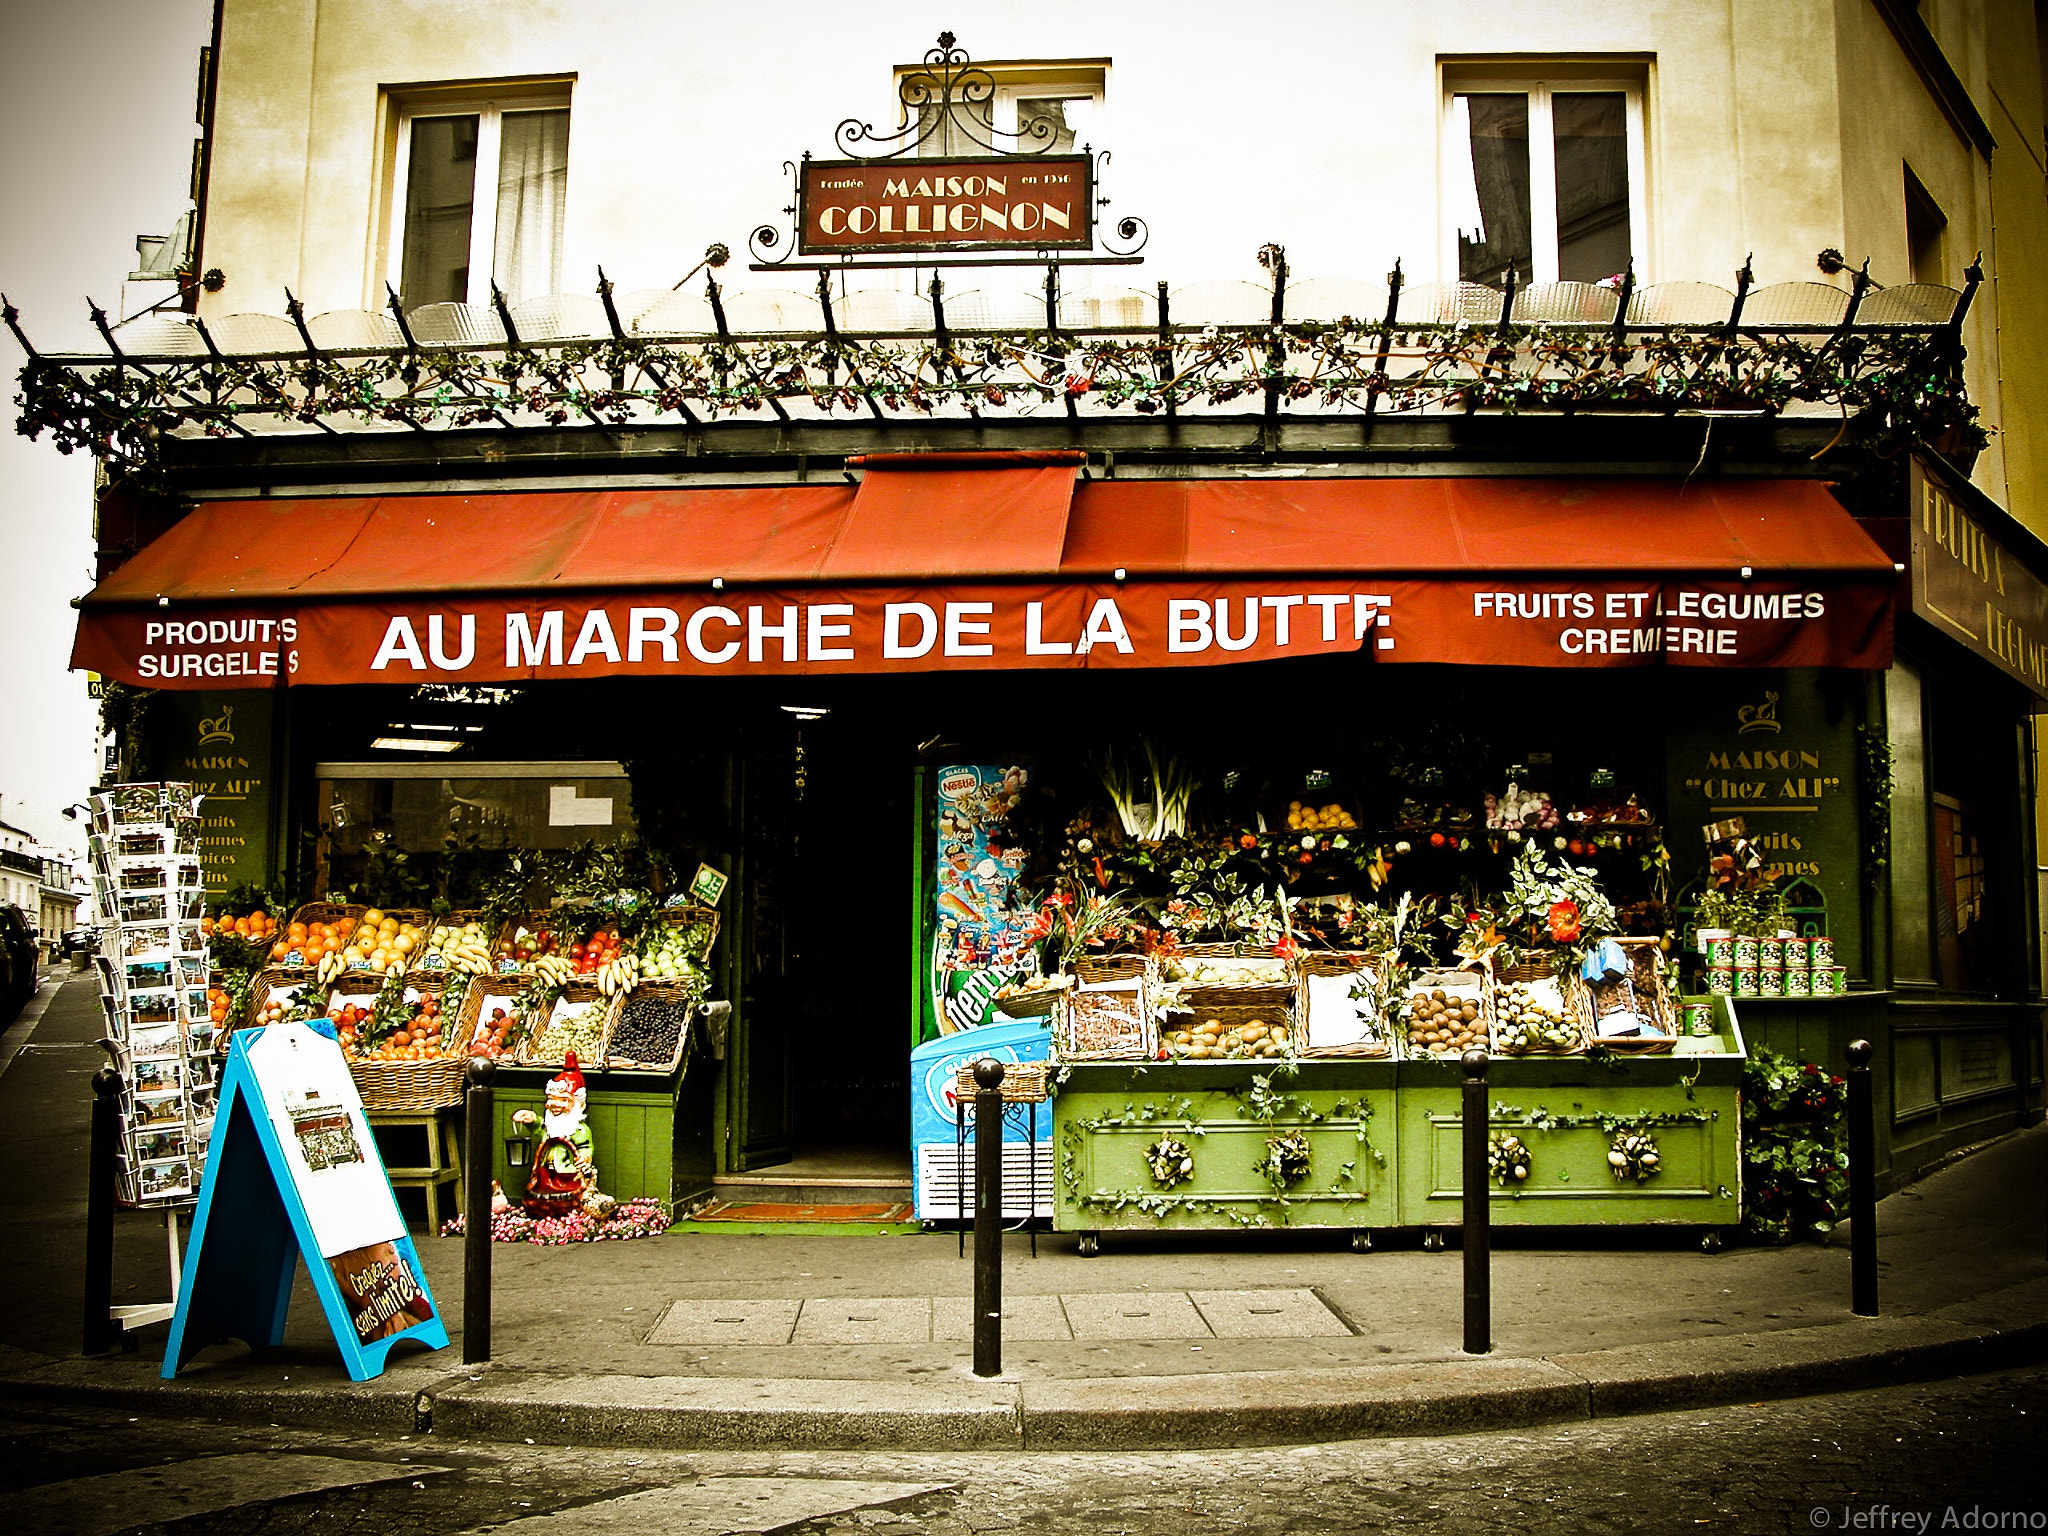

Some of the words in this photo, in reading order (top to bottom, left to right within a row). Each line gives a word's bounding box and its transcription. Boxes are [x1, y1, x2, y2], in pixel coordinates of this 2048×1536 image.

[882, 176, 1007, 198] MAISON
[1021, 176, 1037, 184] en
[819, 202, 1071, 235] COLLIGNON
[1922, 479, 1990, 584] FRUITS
[1474, 592, 1595, 619] FRUITS
[1605, 592, 1649, 619] ET
[1655, 591, 1825, 620] LEGUMES
[145, 618, 297, 645] PRODUITS
[370, 613, 476, 671] AU
[505, 603, 855, 668] MARCHE
[883, 601, 994, 659] DE
[1025, 598, 1135, 656] LA
[1168, 593, 1395, 653] BUTTE
[1559, 626, 1738, 655] CREMERIE
[137, 649, 299, 678] SURGELES
[182, 756, 249, 769] MAISON
[945, 767, 969, 777] GLACES
[1706, 750, 1819, 770] MAISON
[356, 1306, 379, 1336] sans
[370, 1260, 423, 1320] limite!
